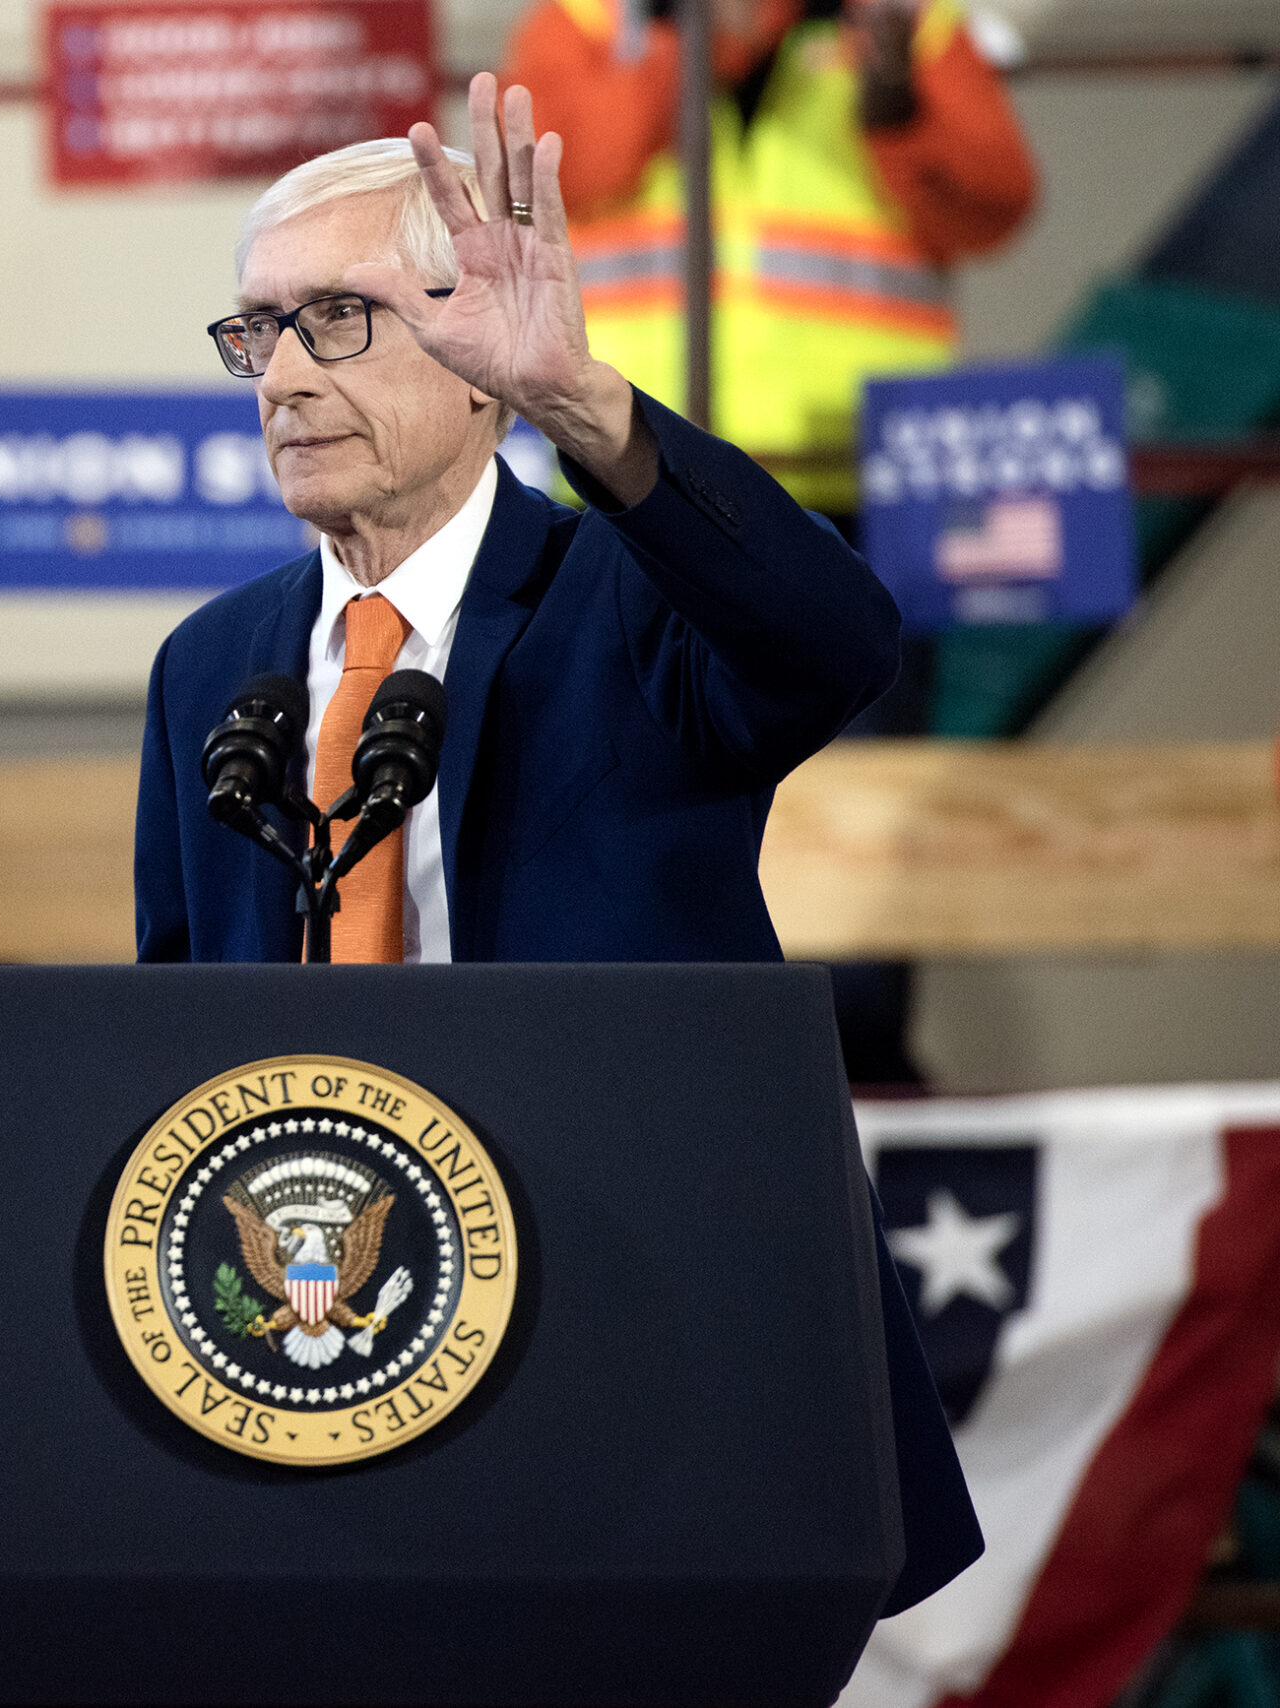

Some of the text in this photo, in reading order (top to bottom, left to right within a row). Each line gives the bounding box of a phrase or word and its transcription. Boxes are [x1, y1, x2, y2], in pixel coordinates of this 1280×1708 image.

[121, 1071, 502, 1444] SEAL OF THE PRESIDENT OF THE UNITED STATES
